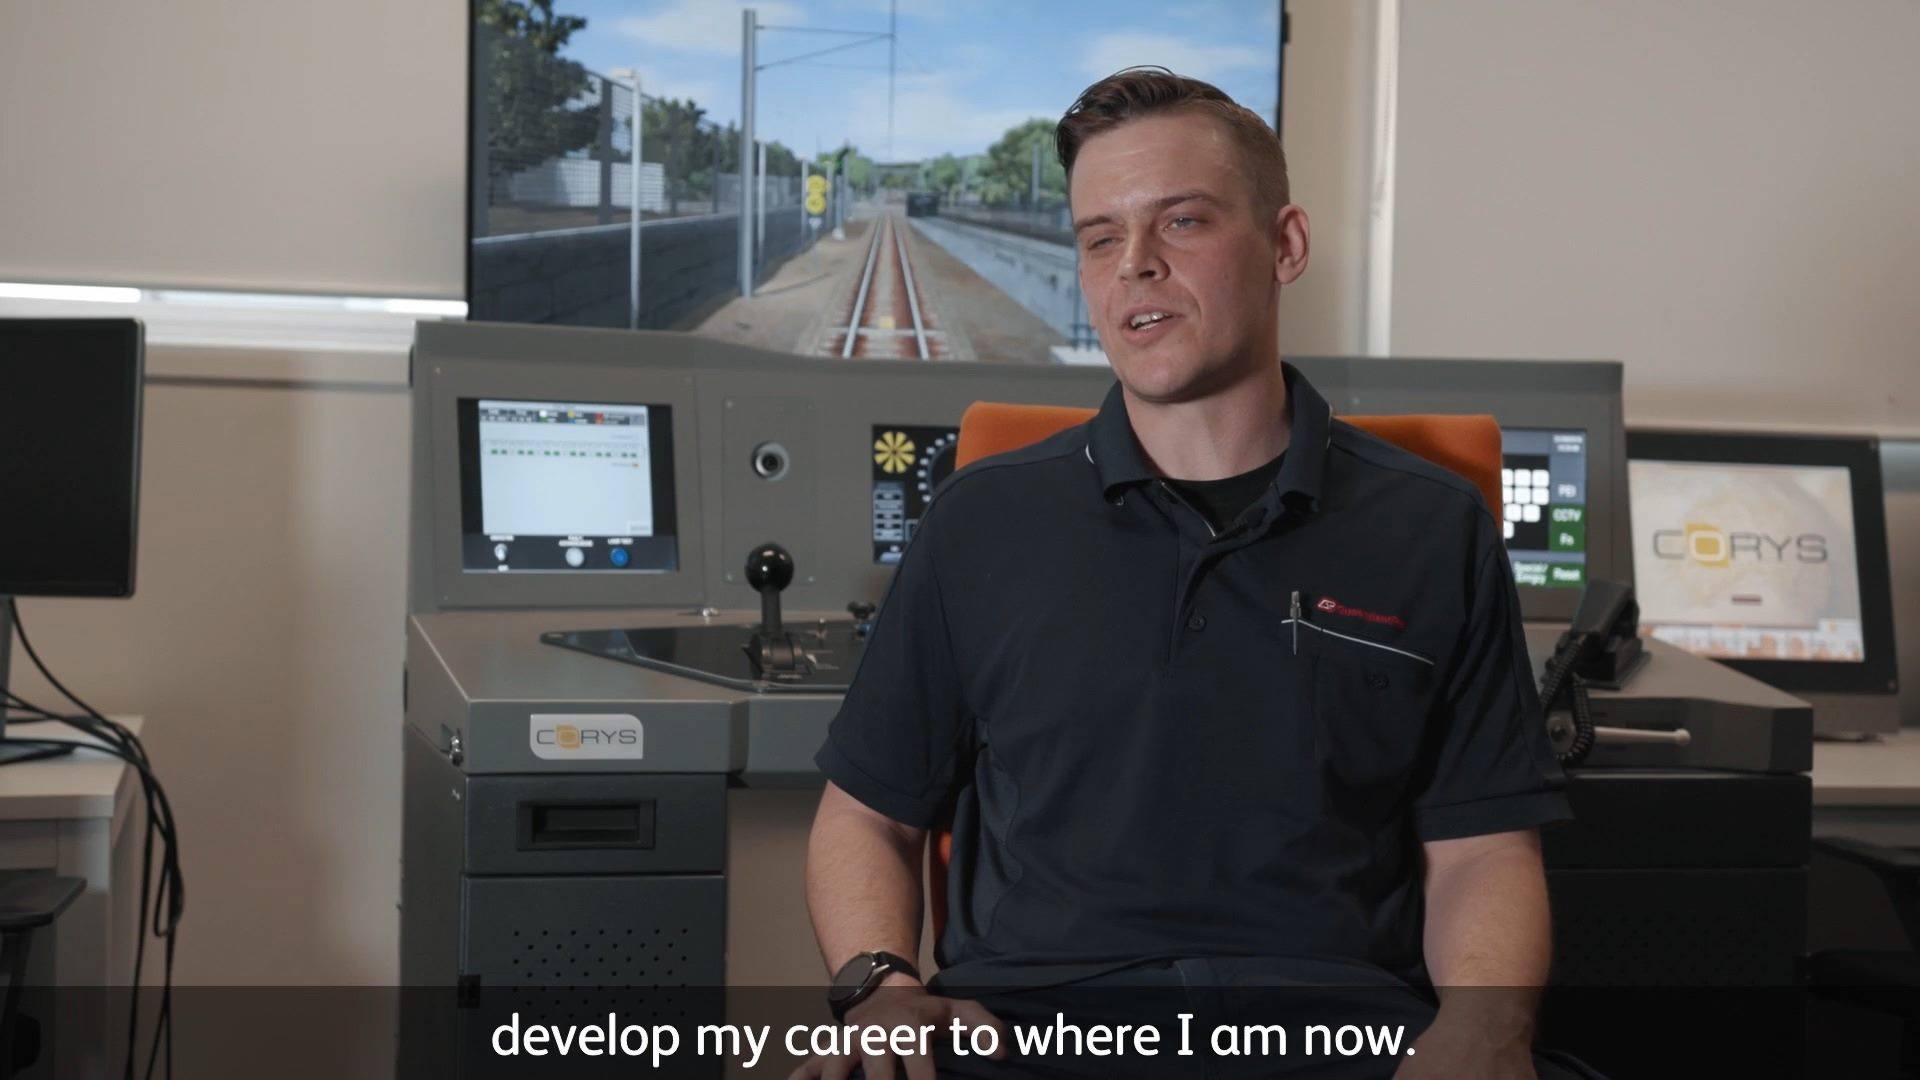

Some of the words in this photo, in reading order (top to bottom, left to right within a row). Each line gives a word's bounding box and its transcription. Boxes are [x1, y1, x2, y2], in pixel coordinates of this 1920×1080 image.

[1552, 508, 1582, 522] CCTV
[1652, 529, 1828, 564] CORYS
[536, 728, 637, 745] CORYS
